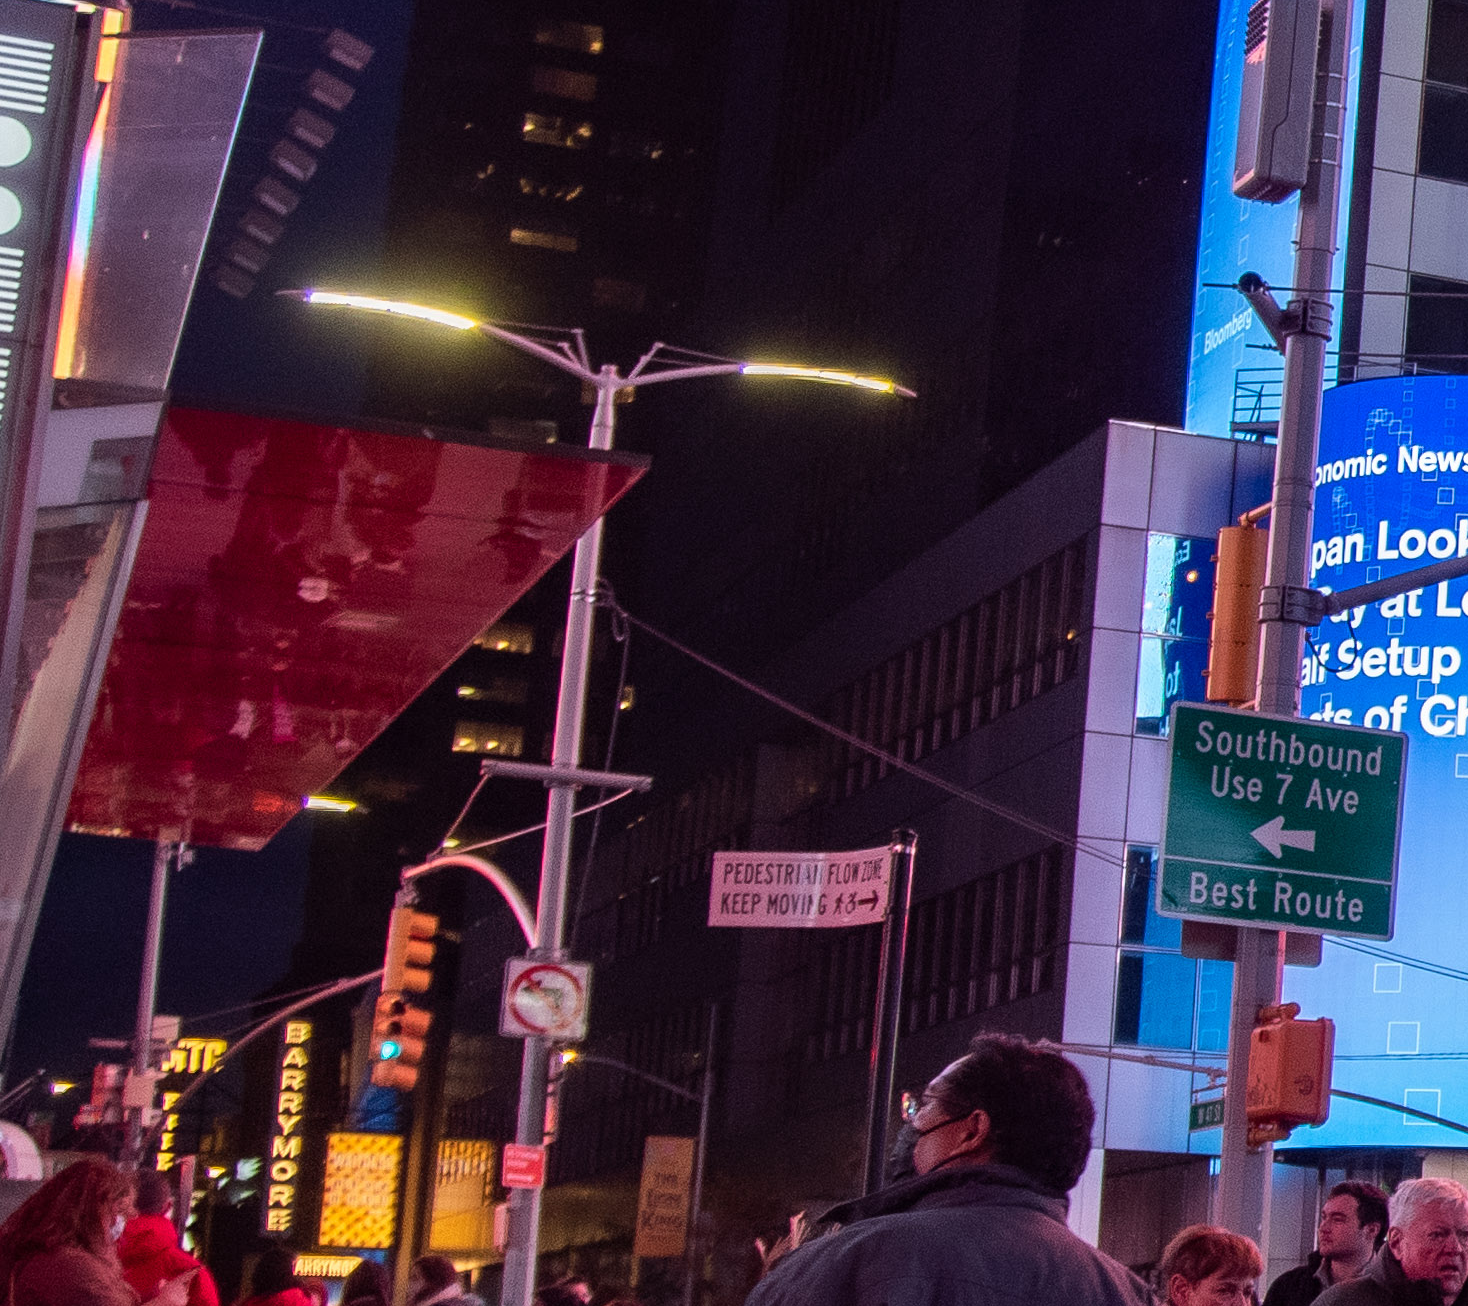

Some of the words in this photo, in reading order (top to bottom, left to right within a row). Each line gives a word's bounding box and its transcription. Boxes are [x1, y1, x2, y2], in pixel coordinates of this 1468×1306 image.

[1204, 307, 1253, 355] Bloomberg
[1315, 449, 1388, 487] onomic
[1312, 531, 1364, 578] pan
[1380, 586, 1424, 617] at
[1302, 643, 1330, 687] alf
[1336, 638, 1462, 684] Setup
[1364, 695, 1408, 733] of
[1195, 722, 1383, 776] Southbound
[1211, 766, 1264, 805] Use
[1274, 775, 1294, 805] 7
[1306, 780, 1361, 815] Ave
[723, 862, 823, 885] PEDESTRIAN
[828, 861, 858, 884] FLOW
[861, 858, 883, 882] ZONE
[721, 893, 761, 915] KEEP
[766, 892, 827, 915] MOVING
[1190, 871, 1262, 913] Best
[1273, 882, 1364, 922] Route
[267, 1021, 312, 1231] BARRYMORE
